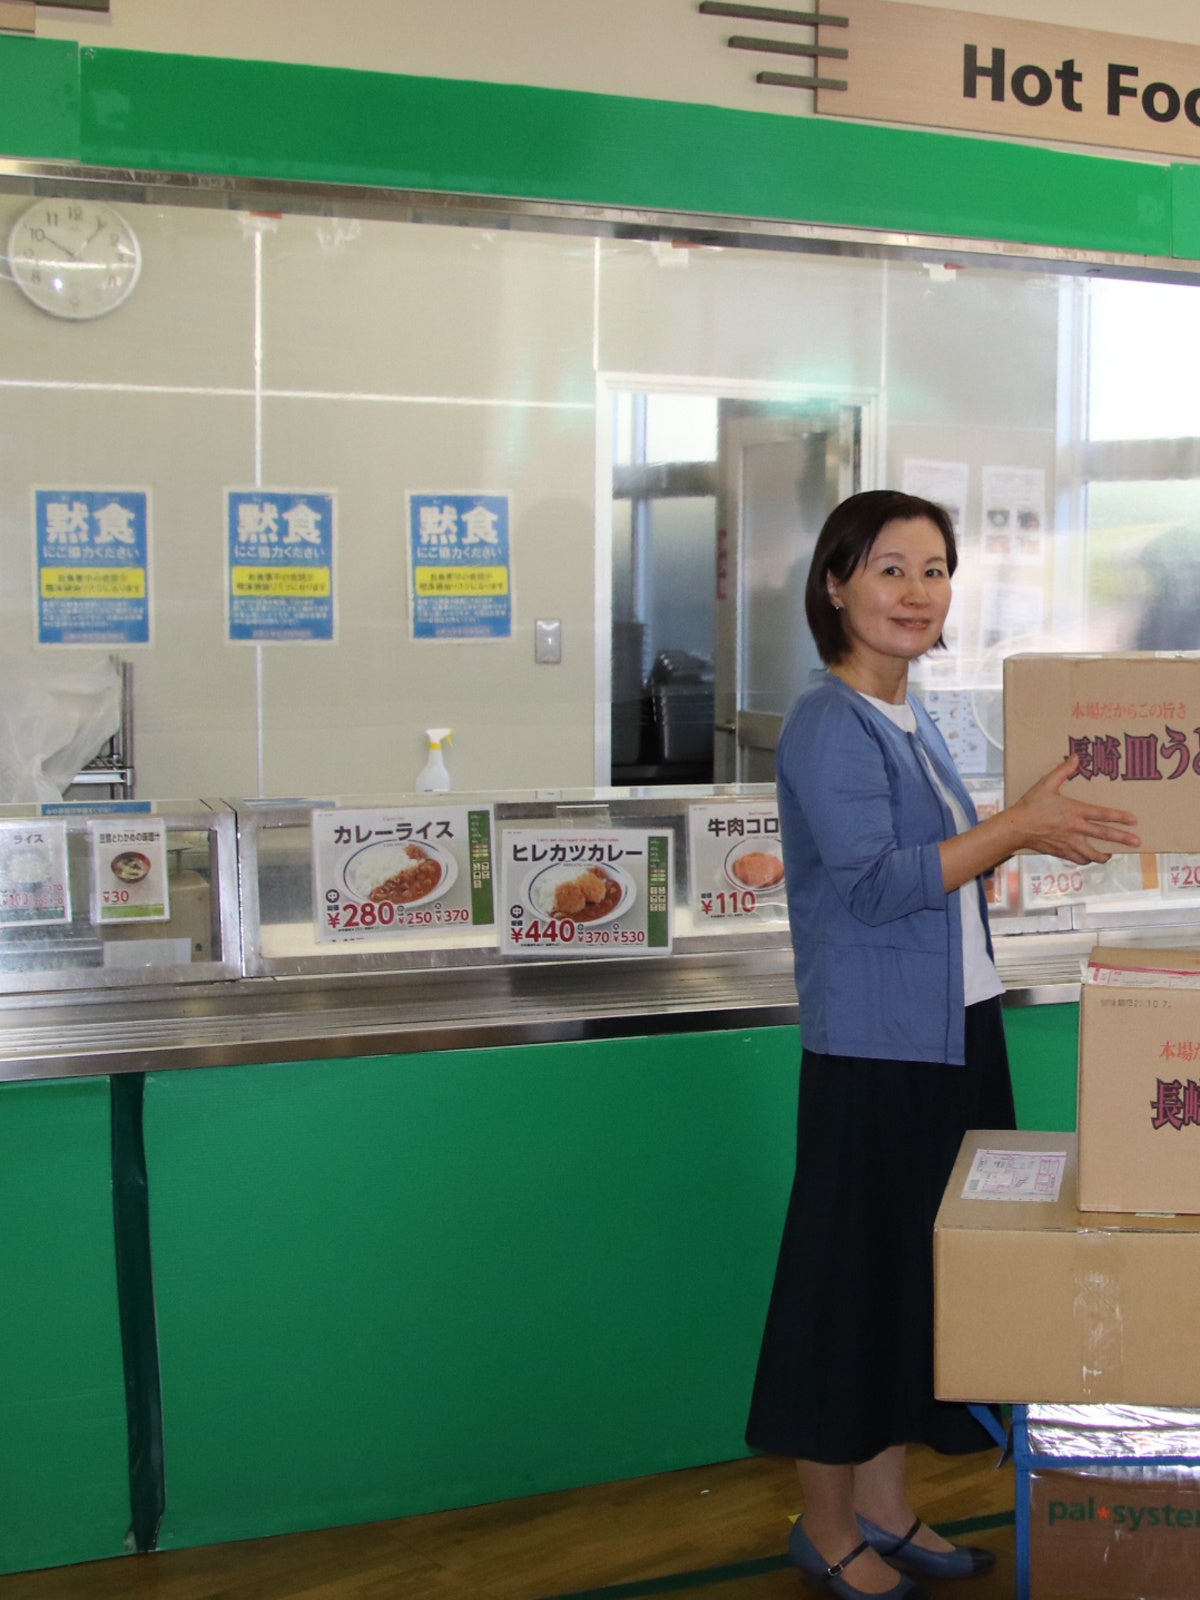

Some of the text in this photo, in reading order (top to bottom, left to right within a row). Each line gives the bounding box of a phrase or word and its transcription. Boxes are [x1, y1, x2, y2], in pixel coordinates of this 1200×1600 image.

[962, 43, 1083, 113] Hot
[47, 211, 58, 226] 11
[46, 501, 136, 544] 黙食
[237, 502, 322, 544] 黙食
[419, 505, 499, 545] 黙食
[234, 546, 326, 559] にご協力ください
[1072, 701, 1187, 720] 本場だからこの旨さ
[13, 833, 44, 845] ライス
[334, 820, 455, 844] カレーライス
[512, 843, 643, 862] ヒレカツカレー
[1031, 871, 1084, 896] ¥200
[327, 902, 395, 928] ¥280
[700, 891, 756, 915] ¥110
[510, 919, 576, 943] ¥440
[1048, 1497, 1097, 1526] pal
